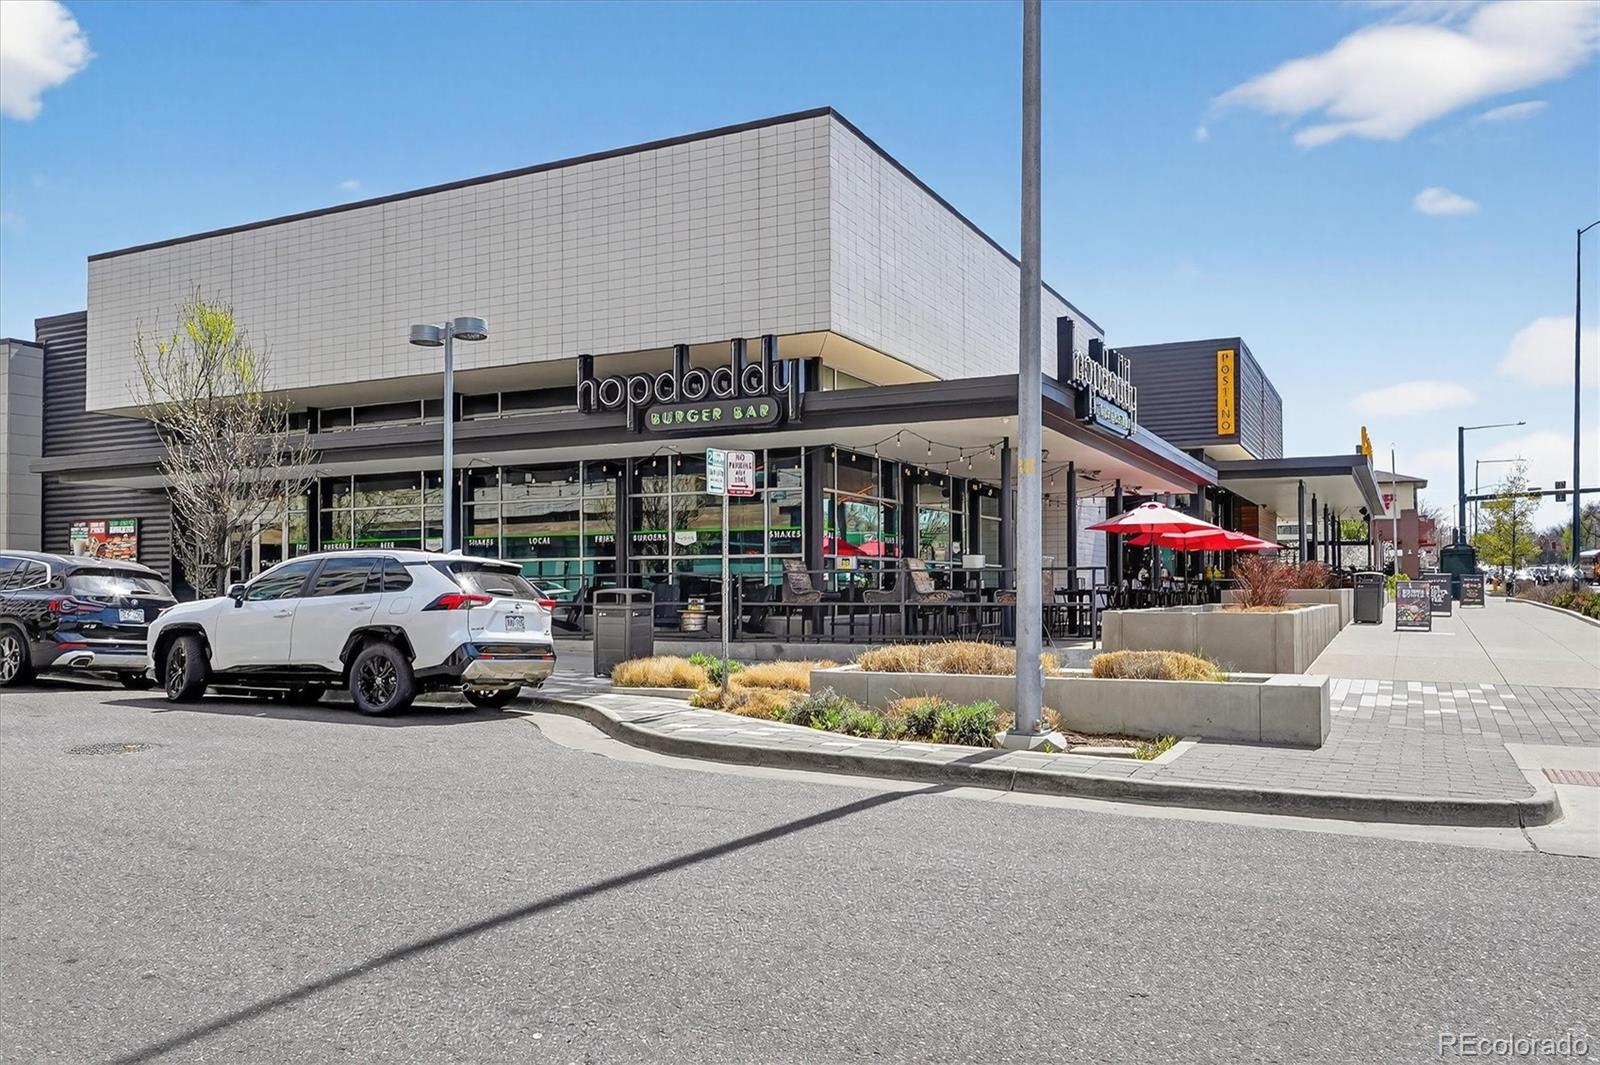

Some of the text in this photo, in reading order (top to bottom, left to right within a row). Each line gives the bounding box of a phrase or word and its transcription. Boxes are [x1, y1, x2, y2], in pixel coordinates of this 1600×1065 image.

[577, 335, 804, 434] hopdoddy
[1221, 353, 1231, 430] POSTINO
[651, 404, 770, 425] BURGER BAR
[735, 453, 745, 461] NO
[528, 537, 551, 545] LOCAL
[769, 530, 801, 538] SHAKES
